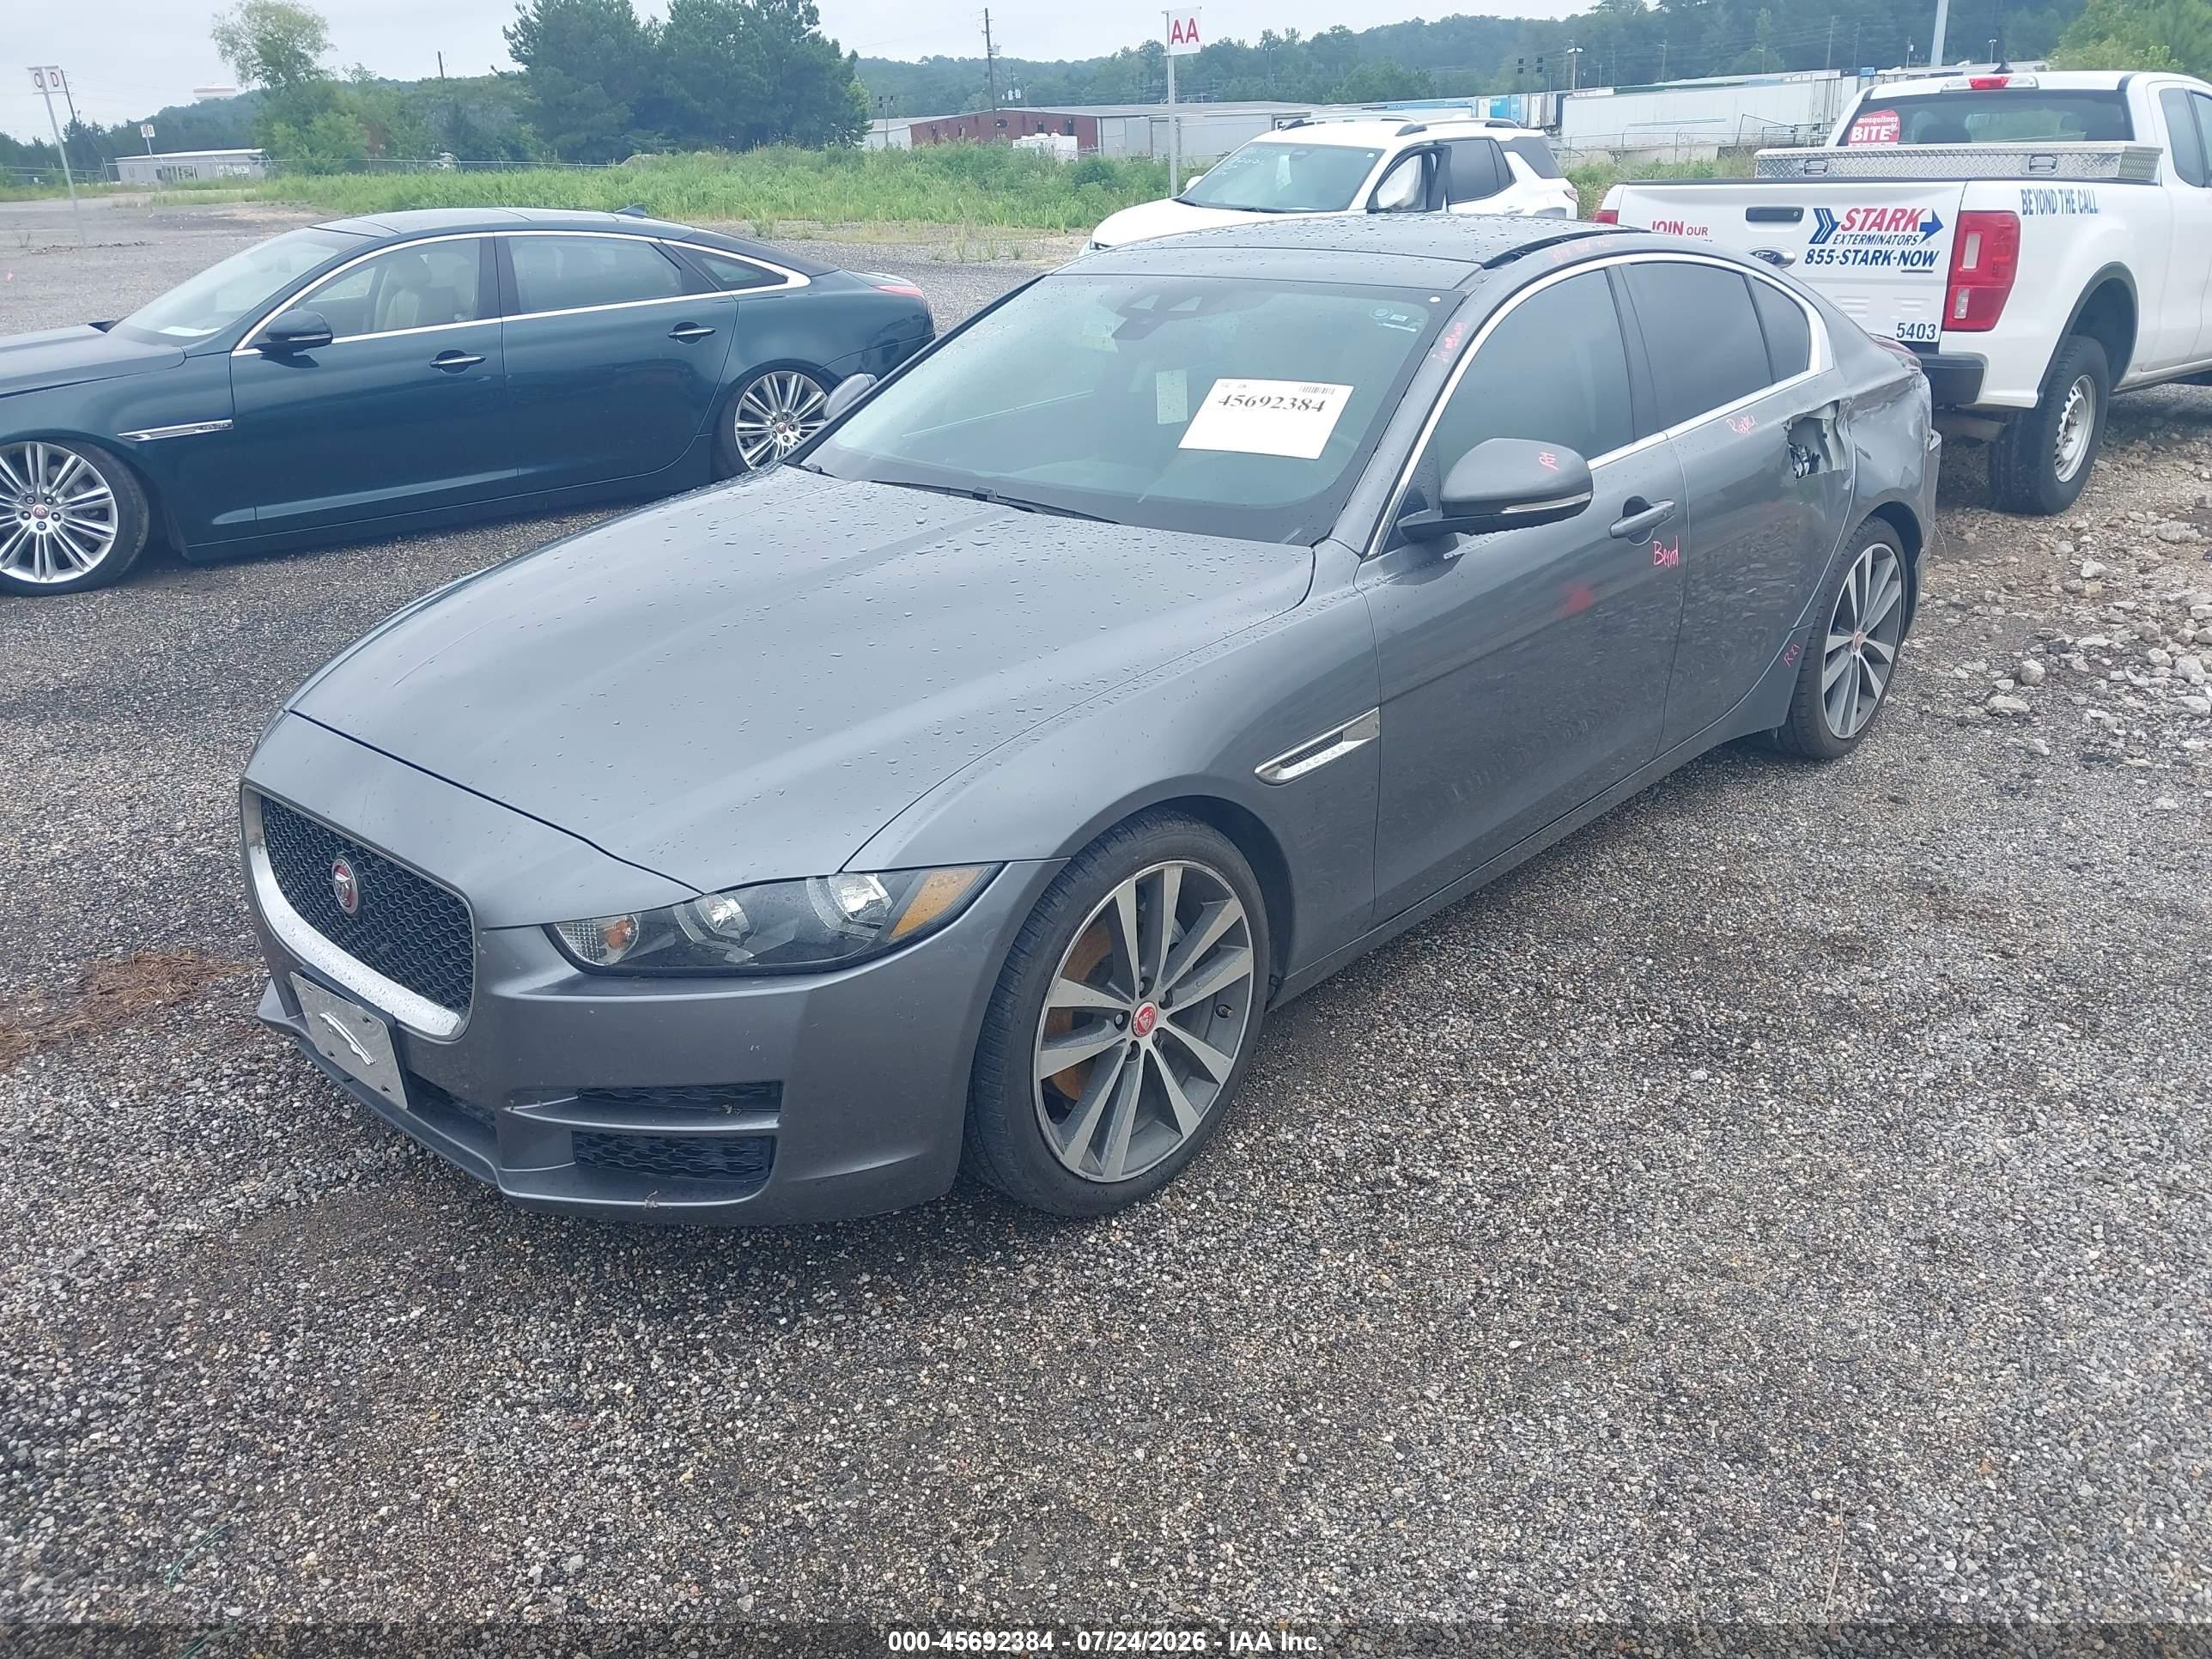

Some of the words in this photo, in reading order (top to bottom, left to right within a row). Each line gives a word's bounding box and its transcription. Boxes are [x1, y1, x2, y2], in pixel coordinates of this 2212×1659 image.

[1170, 18, 1200, 45] AA
[50, 71, 59, 87] D
[1850, 125, 1892, 142] BITE
[2021, 188, 2057, 216] BEYOND
[2058, 188, 2076, 215] THE
[2078, 188, 2099, 214] CALL
[1840, 208, 1927, 232] STARK
[1686, 226, 1709, 236] OUR
[1832, 234, 1920, 246] EXTERMINATORS
[1804, 248, 1940, 267] 855-STARK-NOW
[1896, 322, 1936, 340] 5403
[1218, 393, 1327, 413] 45692384
[1296, 744, 1347, 773] JAGUAR
